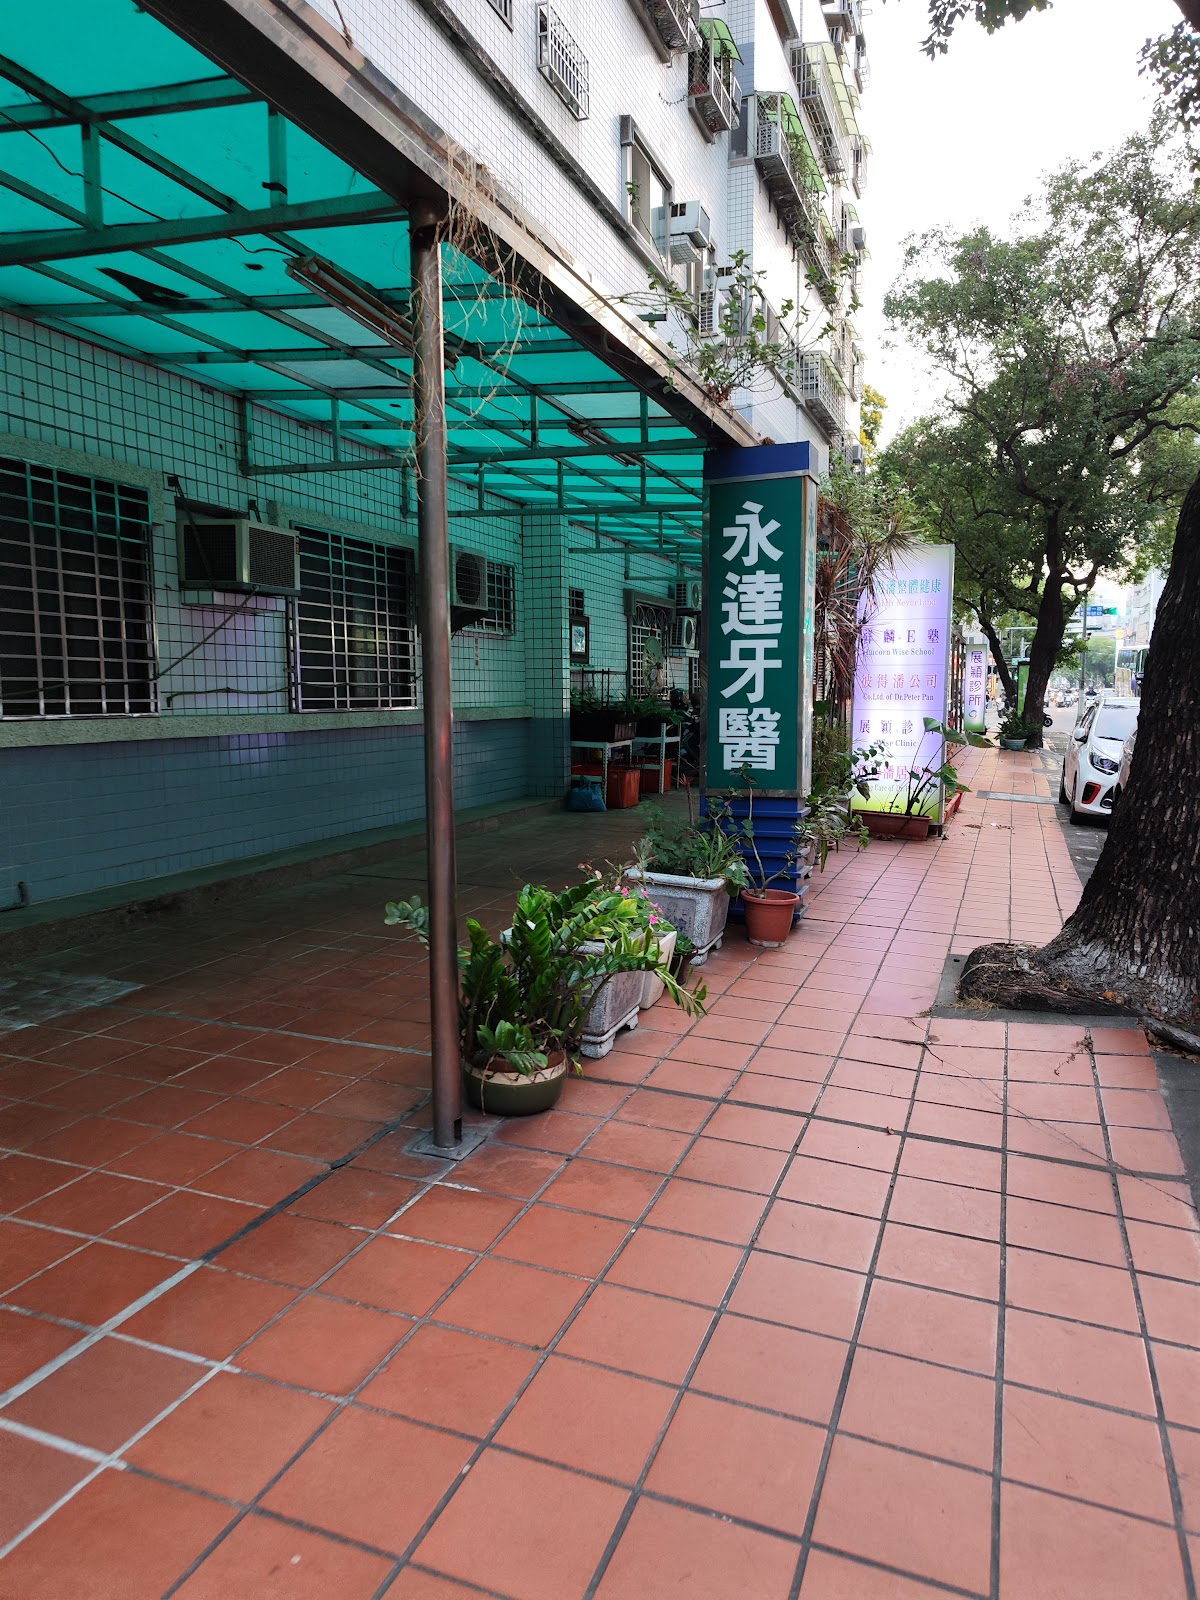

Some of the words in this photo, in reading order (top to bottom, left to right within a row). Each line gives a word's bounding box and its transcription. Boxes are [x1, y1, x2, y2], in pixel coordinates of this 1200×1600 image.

[897, 598, 936, 607] Neverland
[718, 501, 784, 770] 永達牙醫
[892, 648, 910, 656] Wise
[911, 648, 935, 656] School
[861, 674, 938, 689] 彼得潘公司
[969, 650, 982, 706] 展穎診所
[886, 693, 893, 701] of
[922, 693, 934, 701] Pan
[860, 720, 934, 735] 展穎診
[895, 739, 917, 747] Clinic
